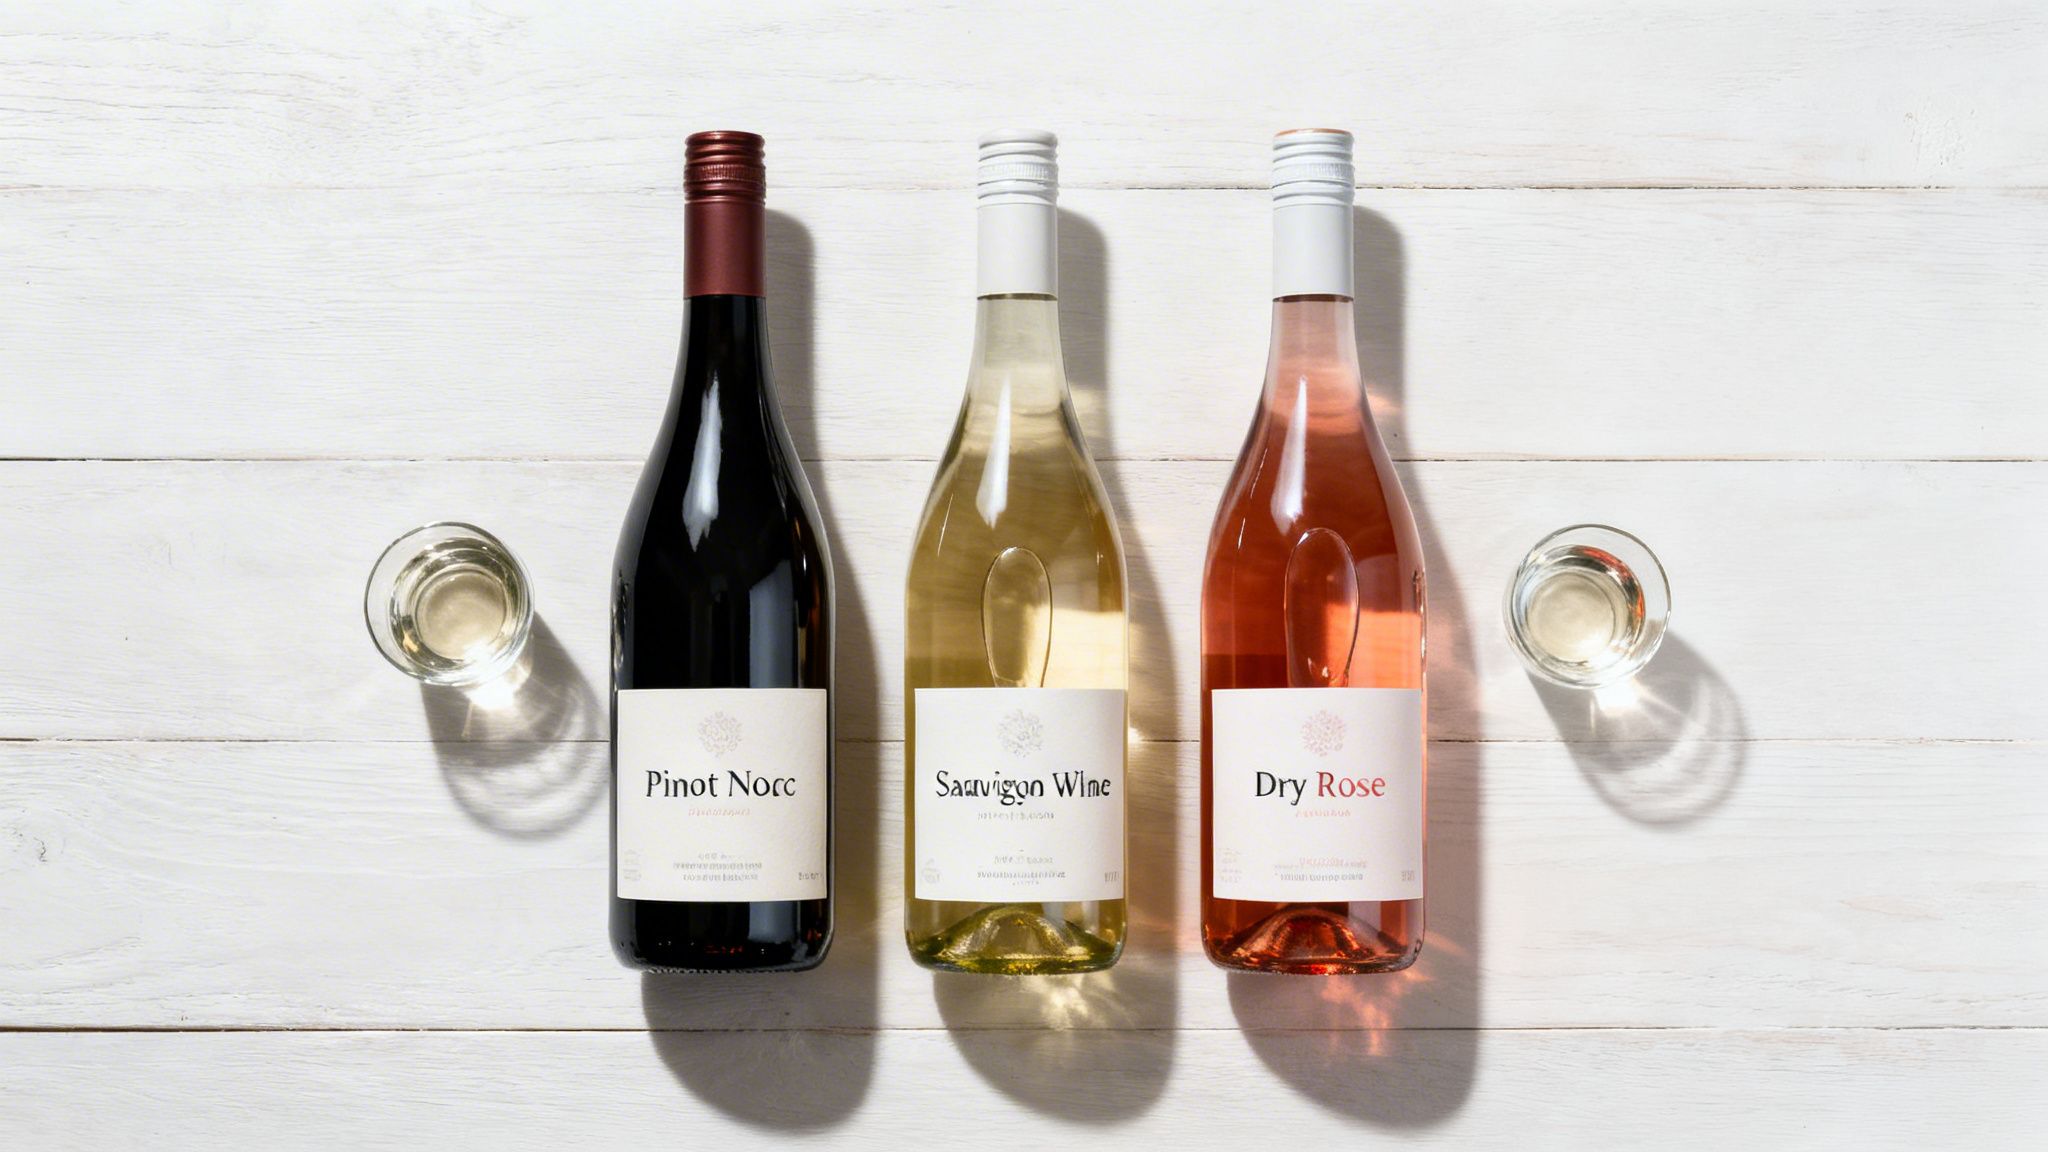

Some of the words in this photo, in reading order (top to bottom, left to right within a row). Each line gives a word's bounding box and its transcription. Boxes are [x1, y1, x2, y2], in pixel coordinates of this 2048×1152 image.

[645, 769, 719, 798] Pinot
[1255, 771, 1308, 807] Dry
[1316, 771, 1387, 798] Rose
